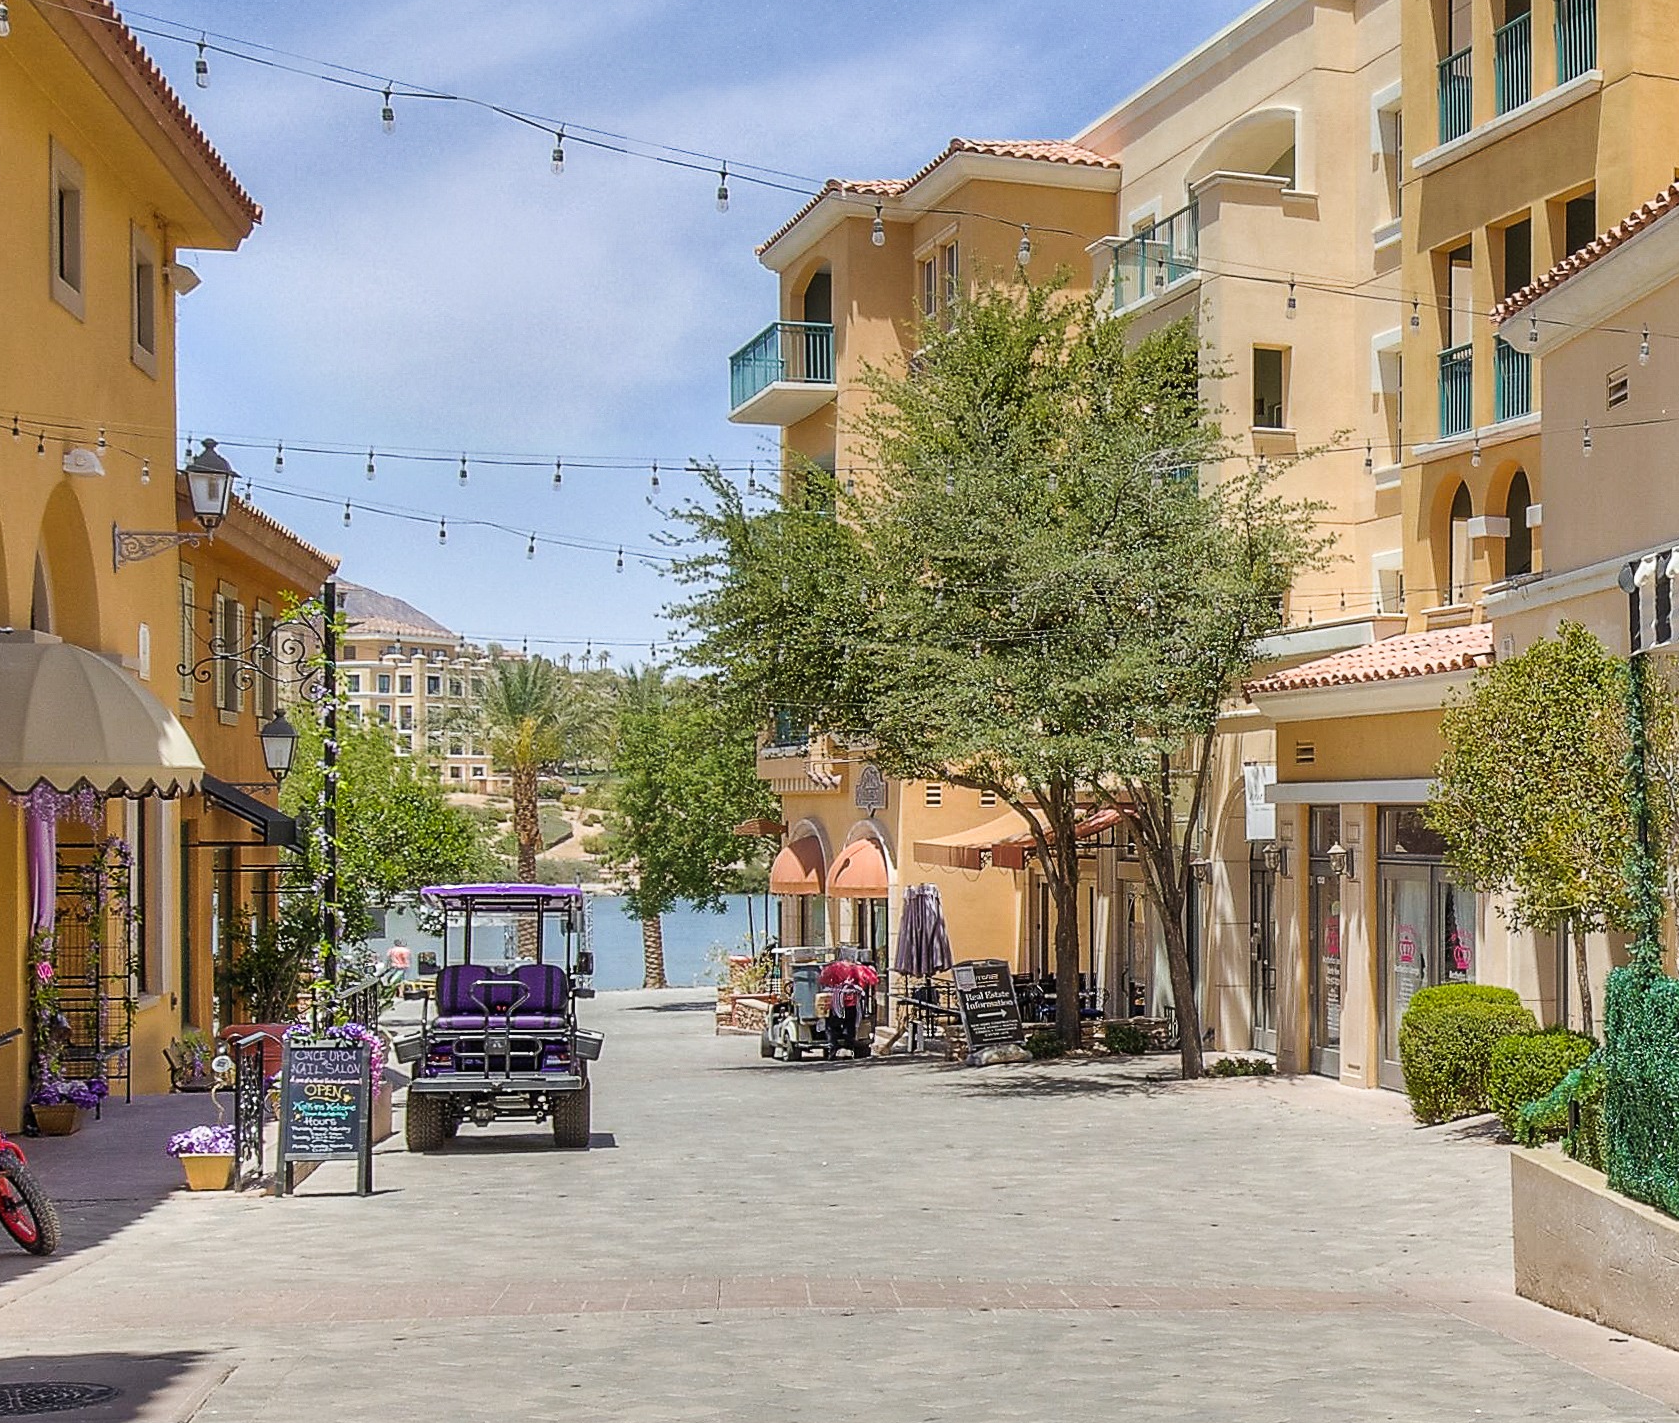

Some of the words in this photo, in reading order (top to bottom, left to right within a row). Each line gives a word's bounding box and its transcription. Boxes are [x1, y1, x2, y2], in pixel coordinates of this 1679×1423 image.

[965, 991, 984, 1002] Real
[984, 990, 1010, 1000] Estate
[965, 998, 1014, 1011] Information
[290, 1062, 324, 1075] NAIL
[325, 1062, 361, 1075] SALON
[304, 1084, 346, 1099] OPEN
